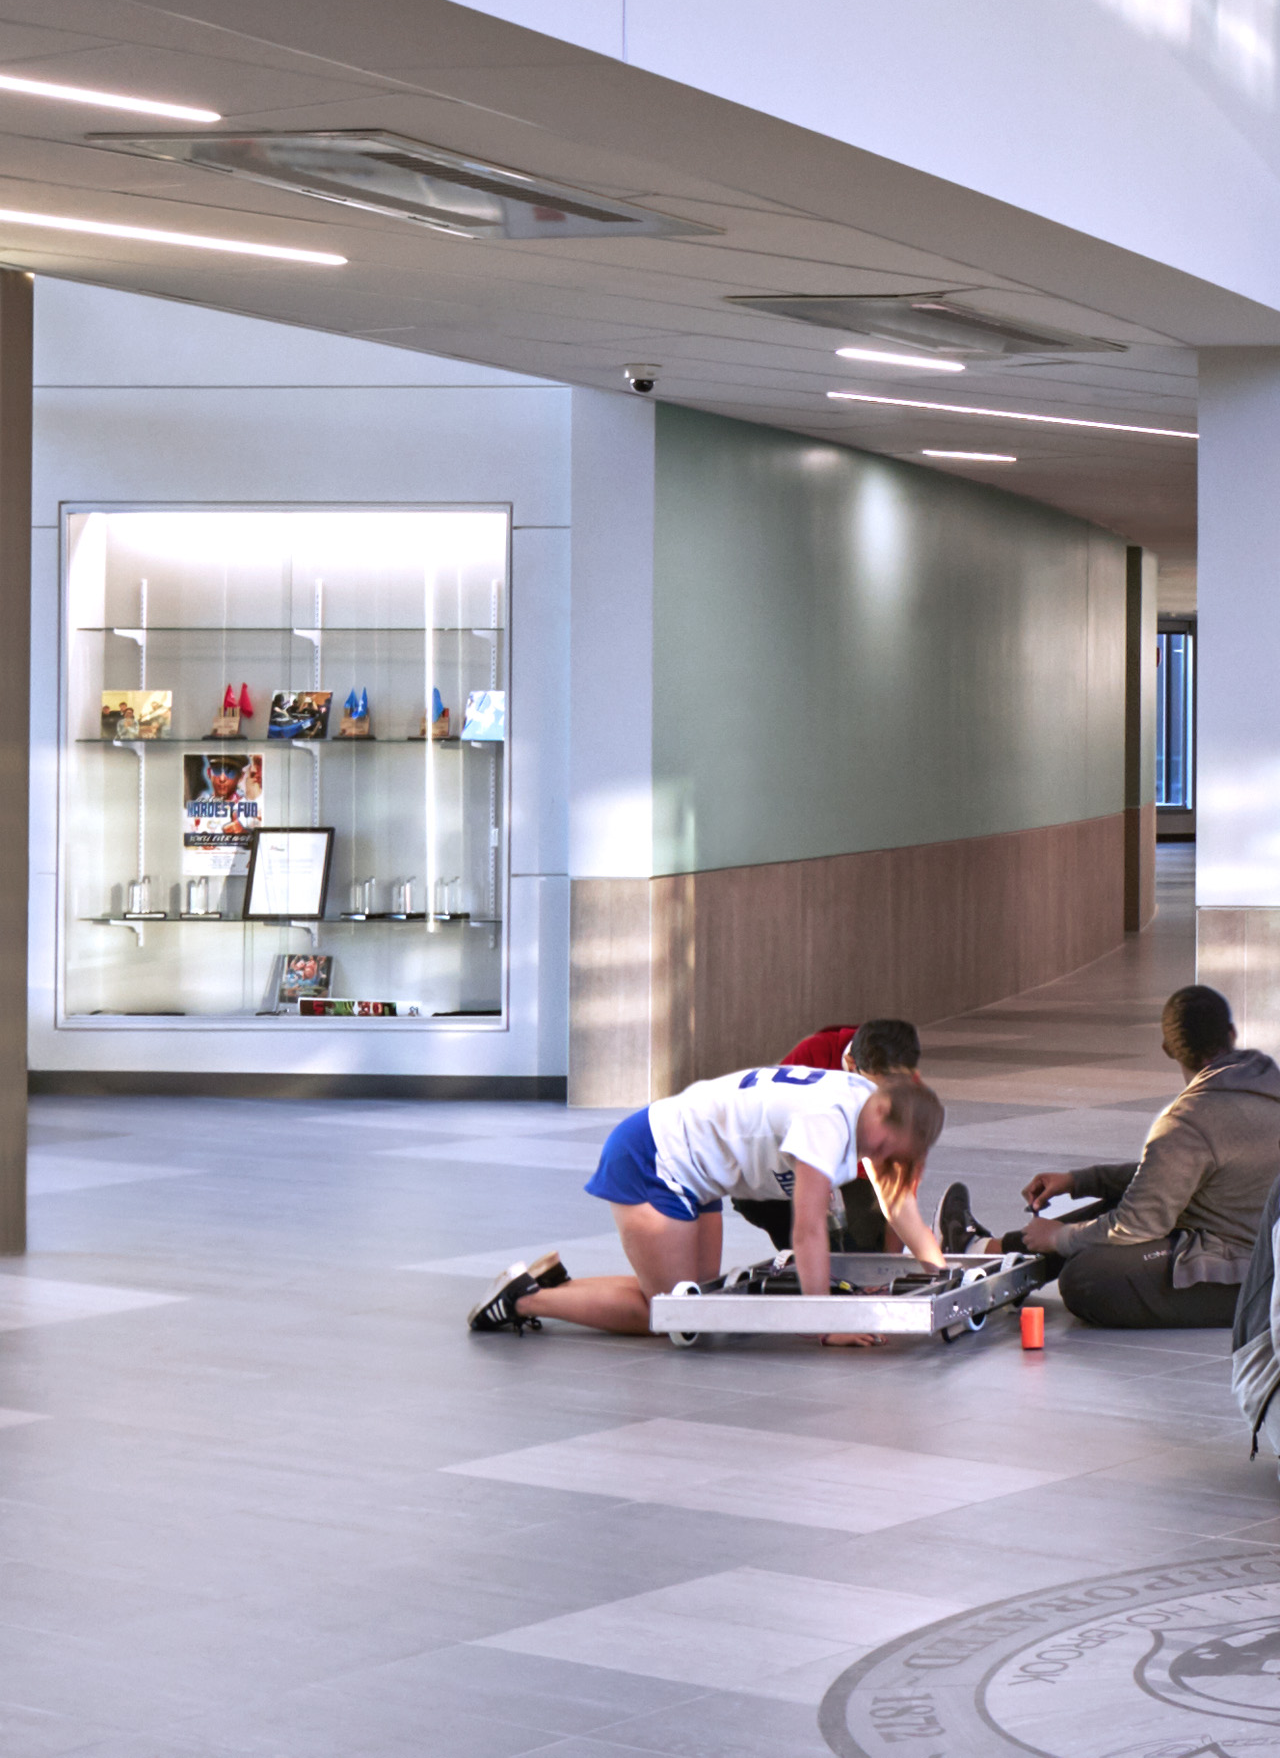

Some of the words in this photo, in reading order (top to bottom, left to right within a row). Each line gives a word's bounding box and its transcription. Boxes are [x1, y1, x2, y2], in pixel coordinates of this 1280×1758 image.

[187, 802, 236, 818] HARDEST
[237, 802, 258, 818] FUN
[1008, 1602, 1206, 1686] HOLBROOK
[868, 1693, 946, 1743] 1872
